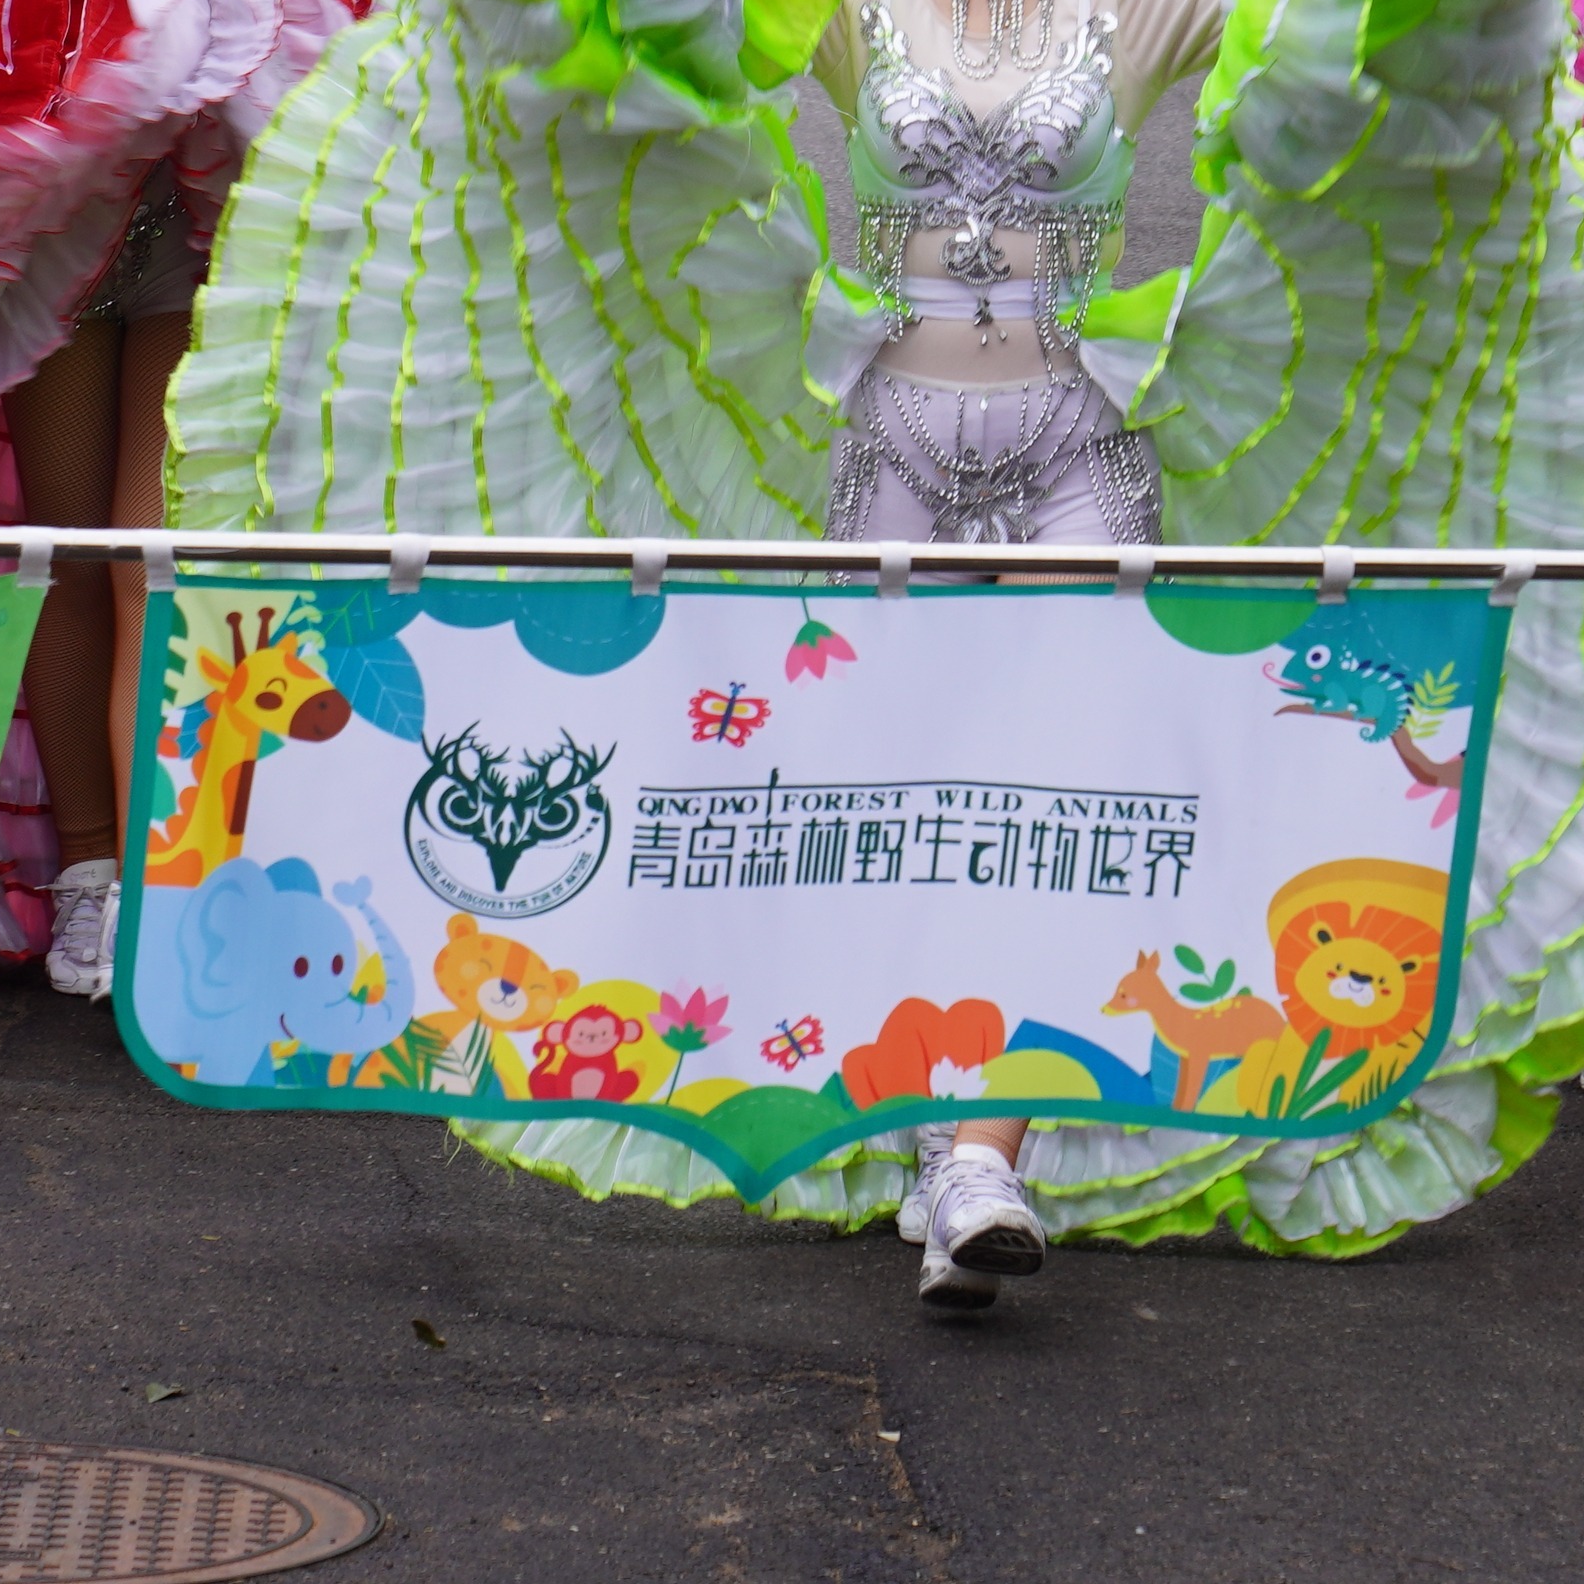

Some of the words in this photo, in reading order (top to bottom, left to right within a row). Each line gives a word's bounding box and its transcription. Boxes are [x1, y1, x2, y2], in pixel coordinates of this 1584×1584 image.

[780, 790, 910, 813] FOREST
[935, 789, 1024, 813] WILD
[1046, 797, 1199, 824] ANIMALS
[418, 838, 441, 877] EXPLORE
[439, 877, 458, 894] AND
[457, 890, 505, 909] DISCOVER
[508, 898, 528, 911] THE
[627, 813, 1196, 898] 青岛森林野生动物世界
